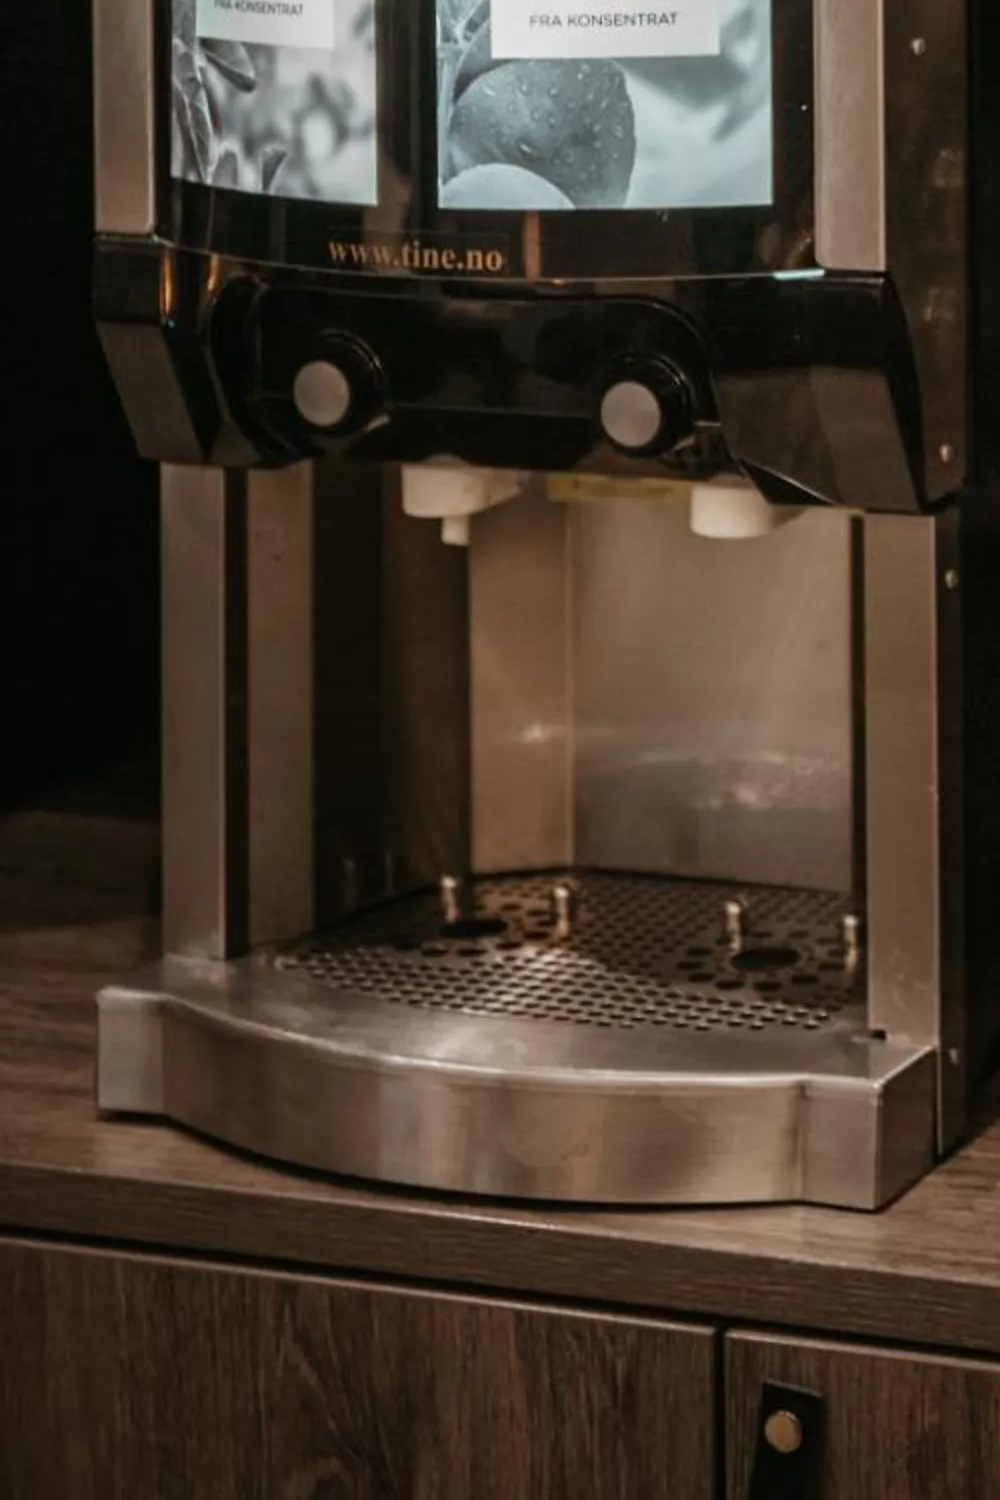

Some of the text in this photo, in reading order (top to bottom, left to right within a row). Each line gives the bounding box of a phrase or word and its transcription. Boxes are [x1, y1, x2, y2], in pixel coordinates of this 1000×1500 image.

[529, 11, 679, 28] FRA KONSENTRAT
[329, 240, 504, 271] www.tine.no
